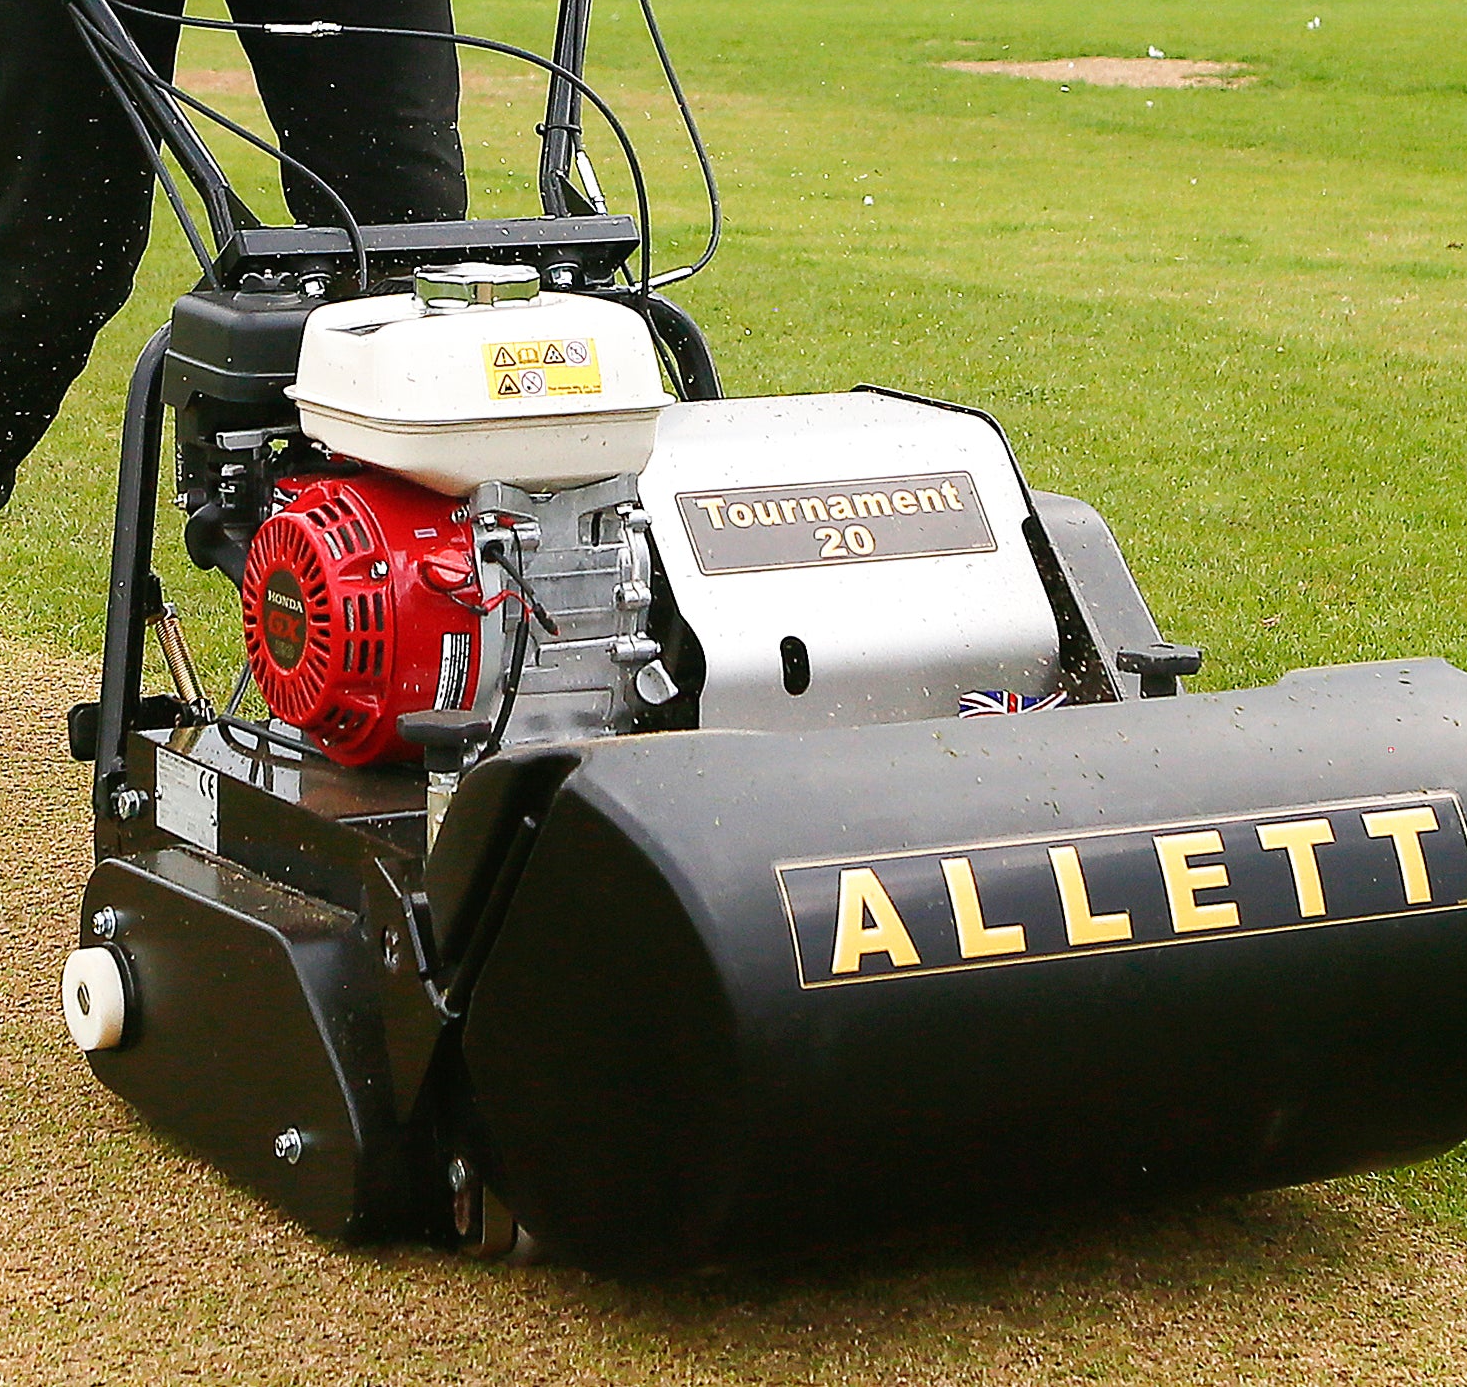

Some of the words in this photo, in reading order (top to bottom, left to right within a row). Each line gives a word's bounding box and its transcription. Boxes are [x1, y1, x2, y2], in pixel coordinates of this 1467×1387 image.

[695, 479, 965, 530] Tournament
[813, 524, 876, 559] 20
[267, 589, 304, 614] HONDA
[268, 610, 301, 643] GX
[831, 805, 1439, 974] ALLETT
